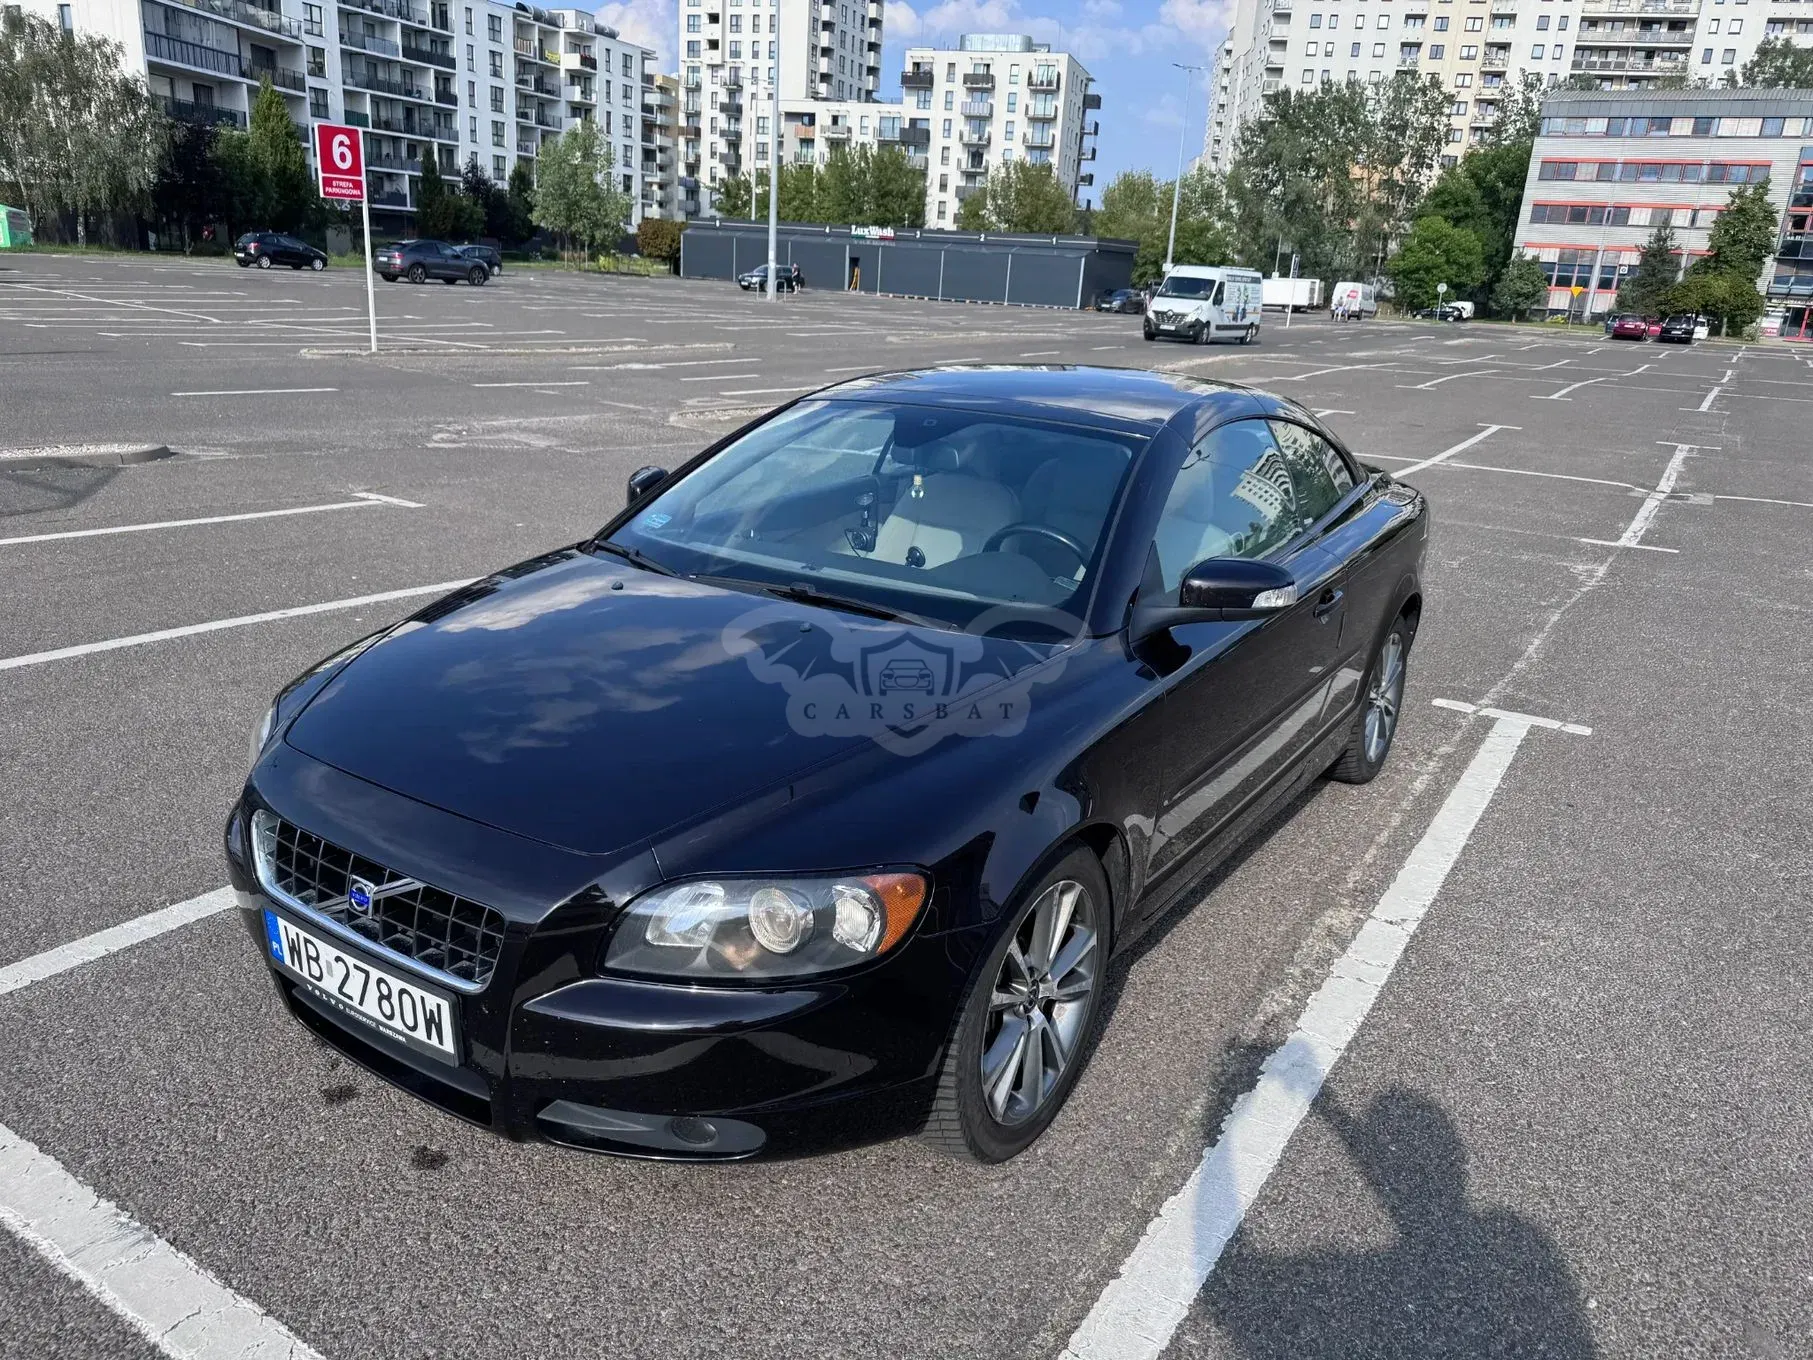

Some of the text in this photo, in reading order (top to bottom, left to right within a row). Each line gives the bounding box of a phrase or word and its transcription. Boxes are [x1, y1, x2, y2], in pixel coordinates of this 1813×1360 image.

[333, 134, 352, 170] 6
[325, 187, 361, 196] PARKINGOWA
[332, 180, 354, 188] STREFA
[851, 225, 894, 237] LuxWash
[272, 941, 283, 956] PL
[284, 925, 324, 983] WB
[306, 983, 344, 1010] VOLVO
[378, 1024, 407, 1044] WARSZAWA
